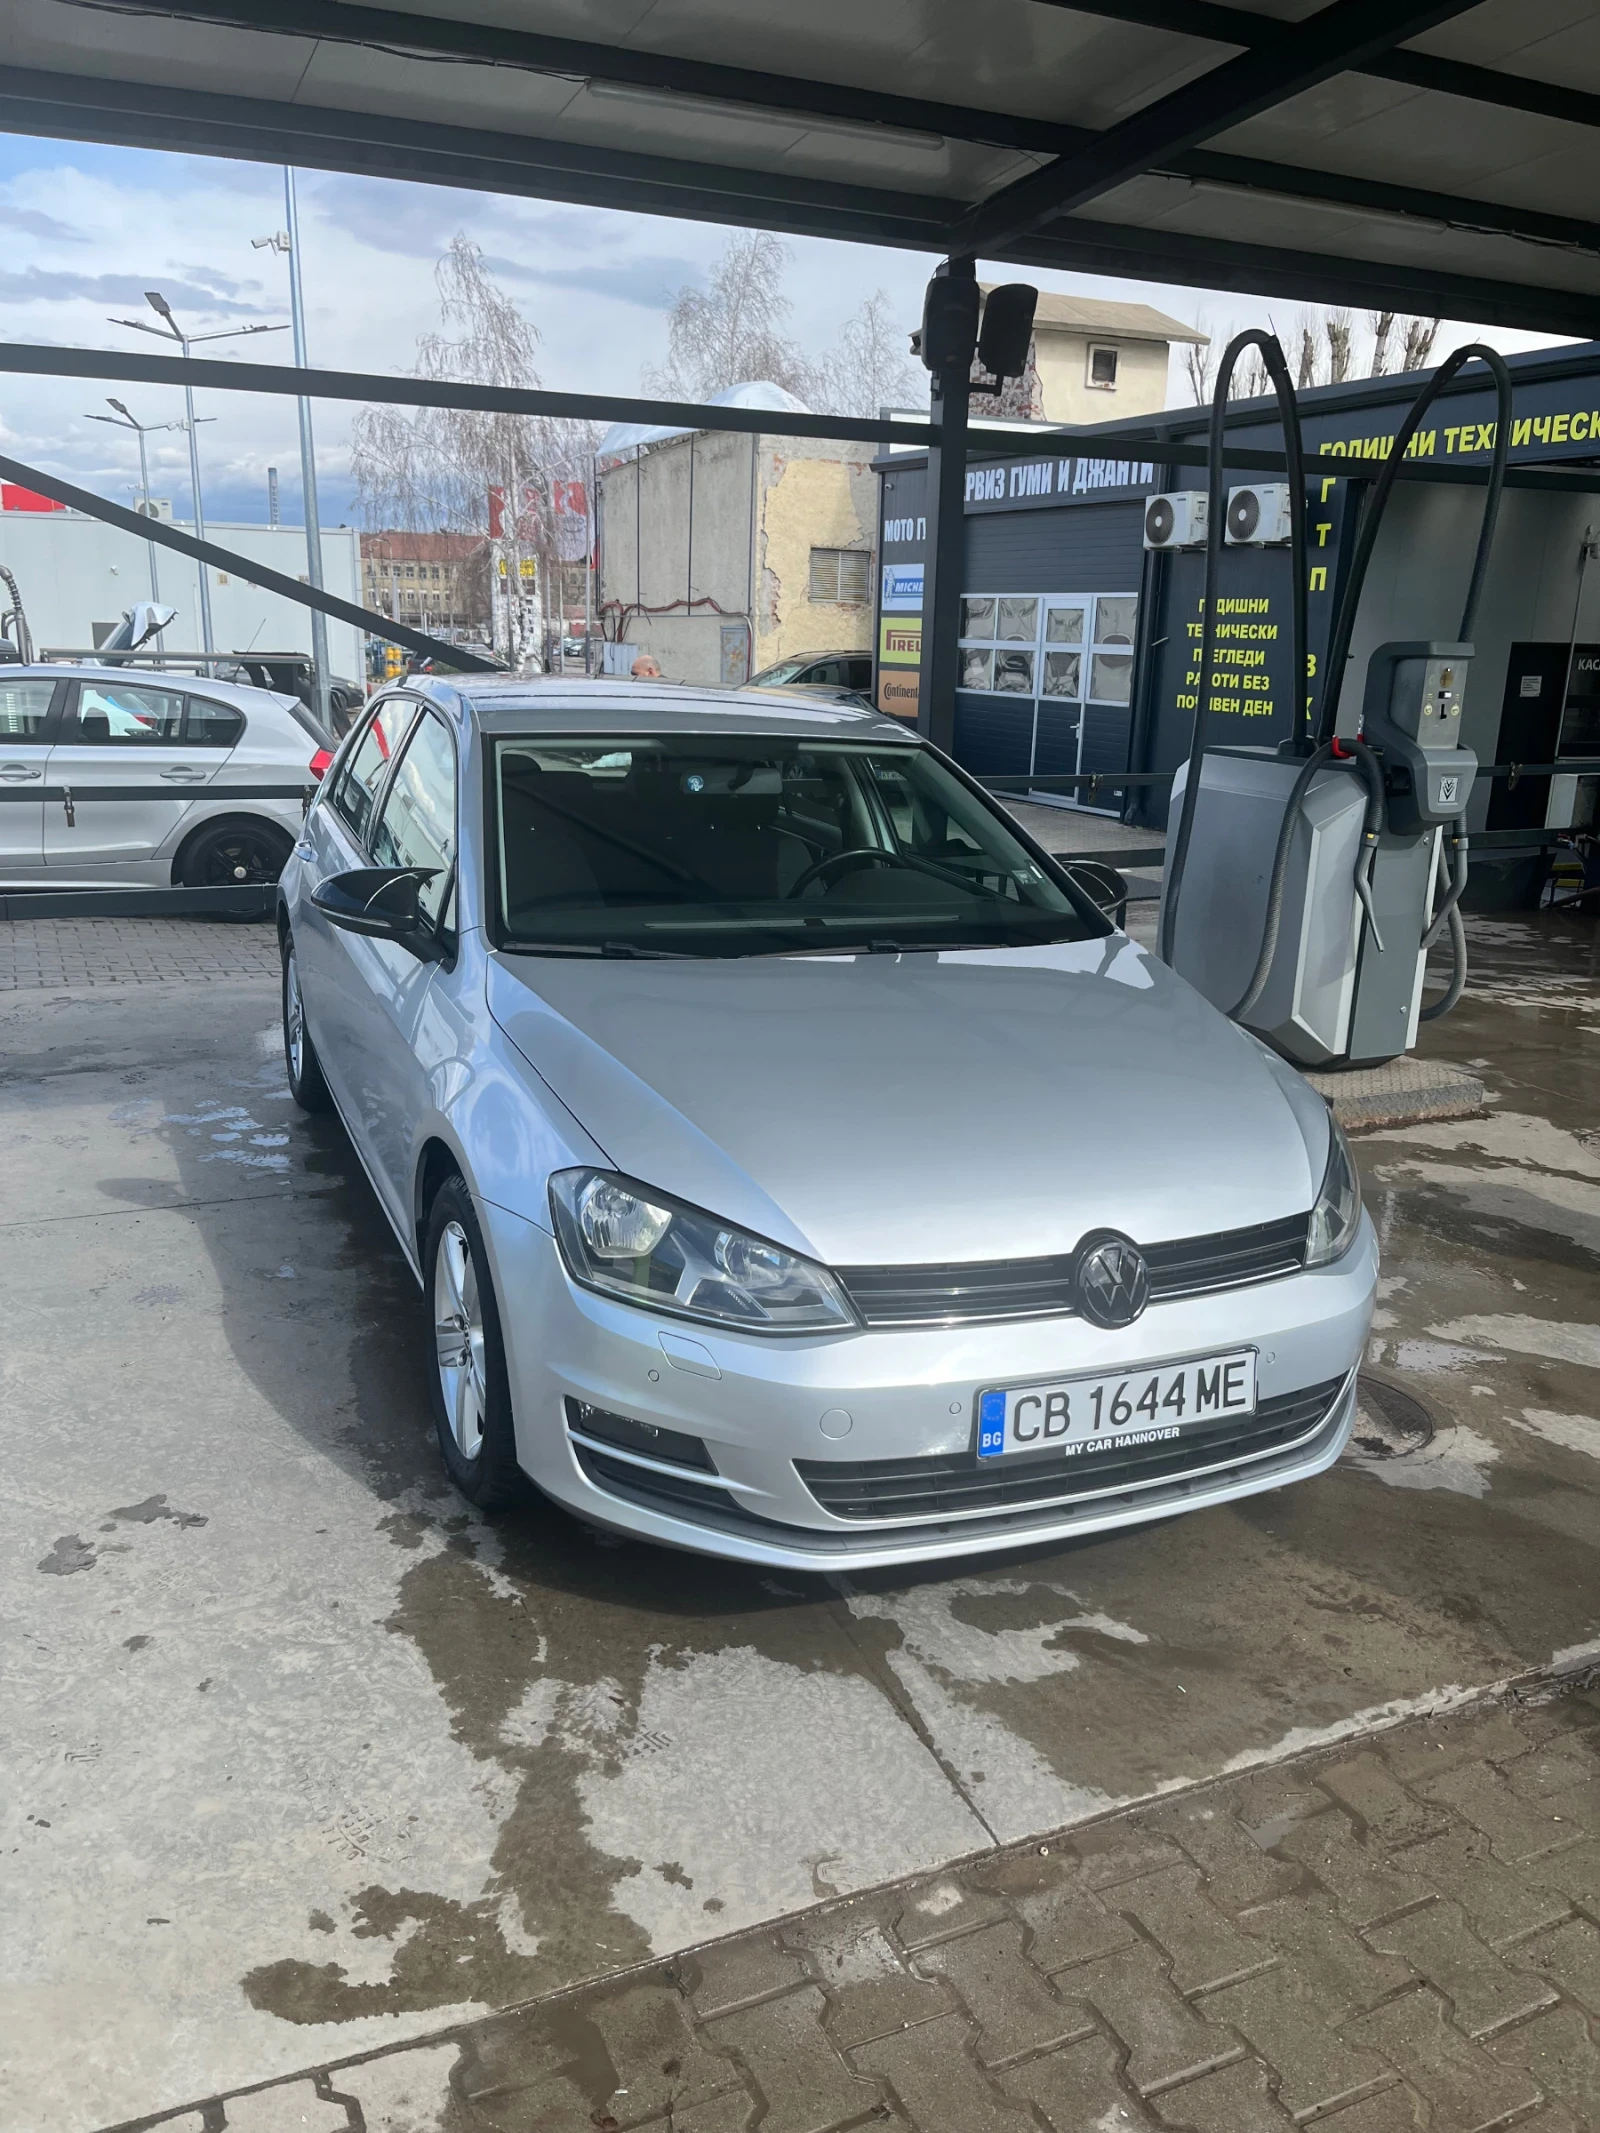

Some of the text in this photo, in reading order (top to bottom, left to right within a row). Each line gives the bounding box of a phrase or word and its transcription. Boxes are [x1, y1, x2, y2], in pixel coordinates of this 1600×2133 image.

[1443, 410, 1600, 454] ТЕХИЧЕСК
[964, 457, 1154, 502] РВИЗ ГУМИ И ДЖАНТИ
[884, 517, 914, 542] МОТО
[895, 581, 924, 593] MICHE
[1198, 598, 1269, 616] ГДИШНИ
[1186, 623, 1278, 640] ТЕИЧЕСКИ
[1192, 648, 1266, 667] ПЕГЛЕДИ
[1577, 658, 1600, 671] КАС
[1185, 671, 1270, 691] РАОТИ БЕЗ
[884, 682, 919, 700] Continent
[1176, 694, 1274, 717] ПОВЕН ДЕН
[1012, 1360, 1247, 1442] CB 1644 ME
[982, 1431, 1002, 1448] BG
[1065, 1427, 1180, 1456] MY CAR HANNOVER
